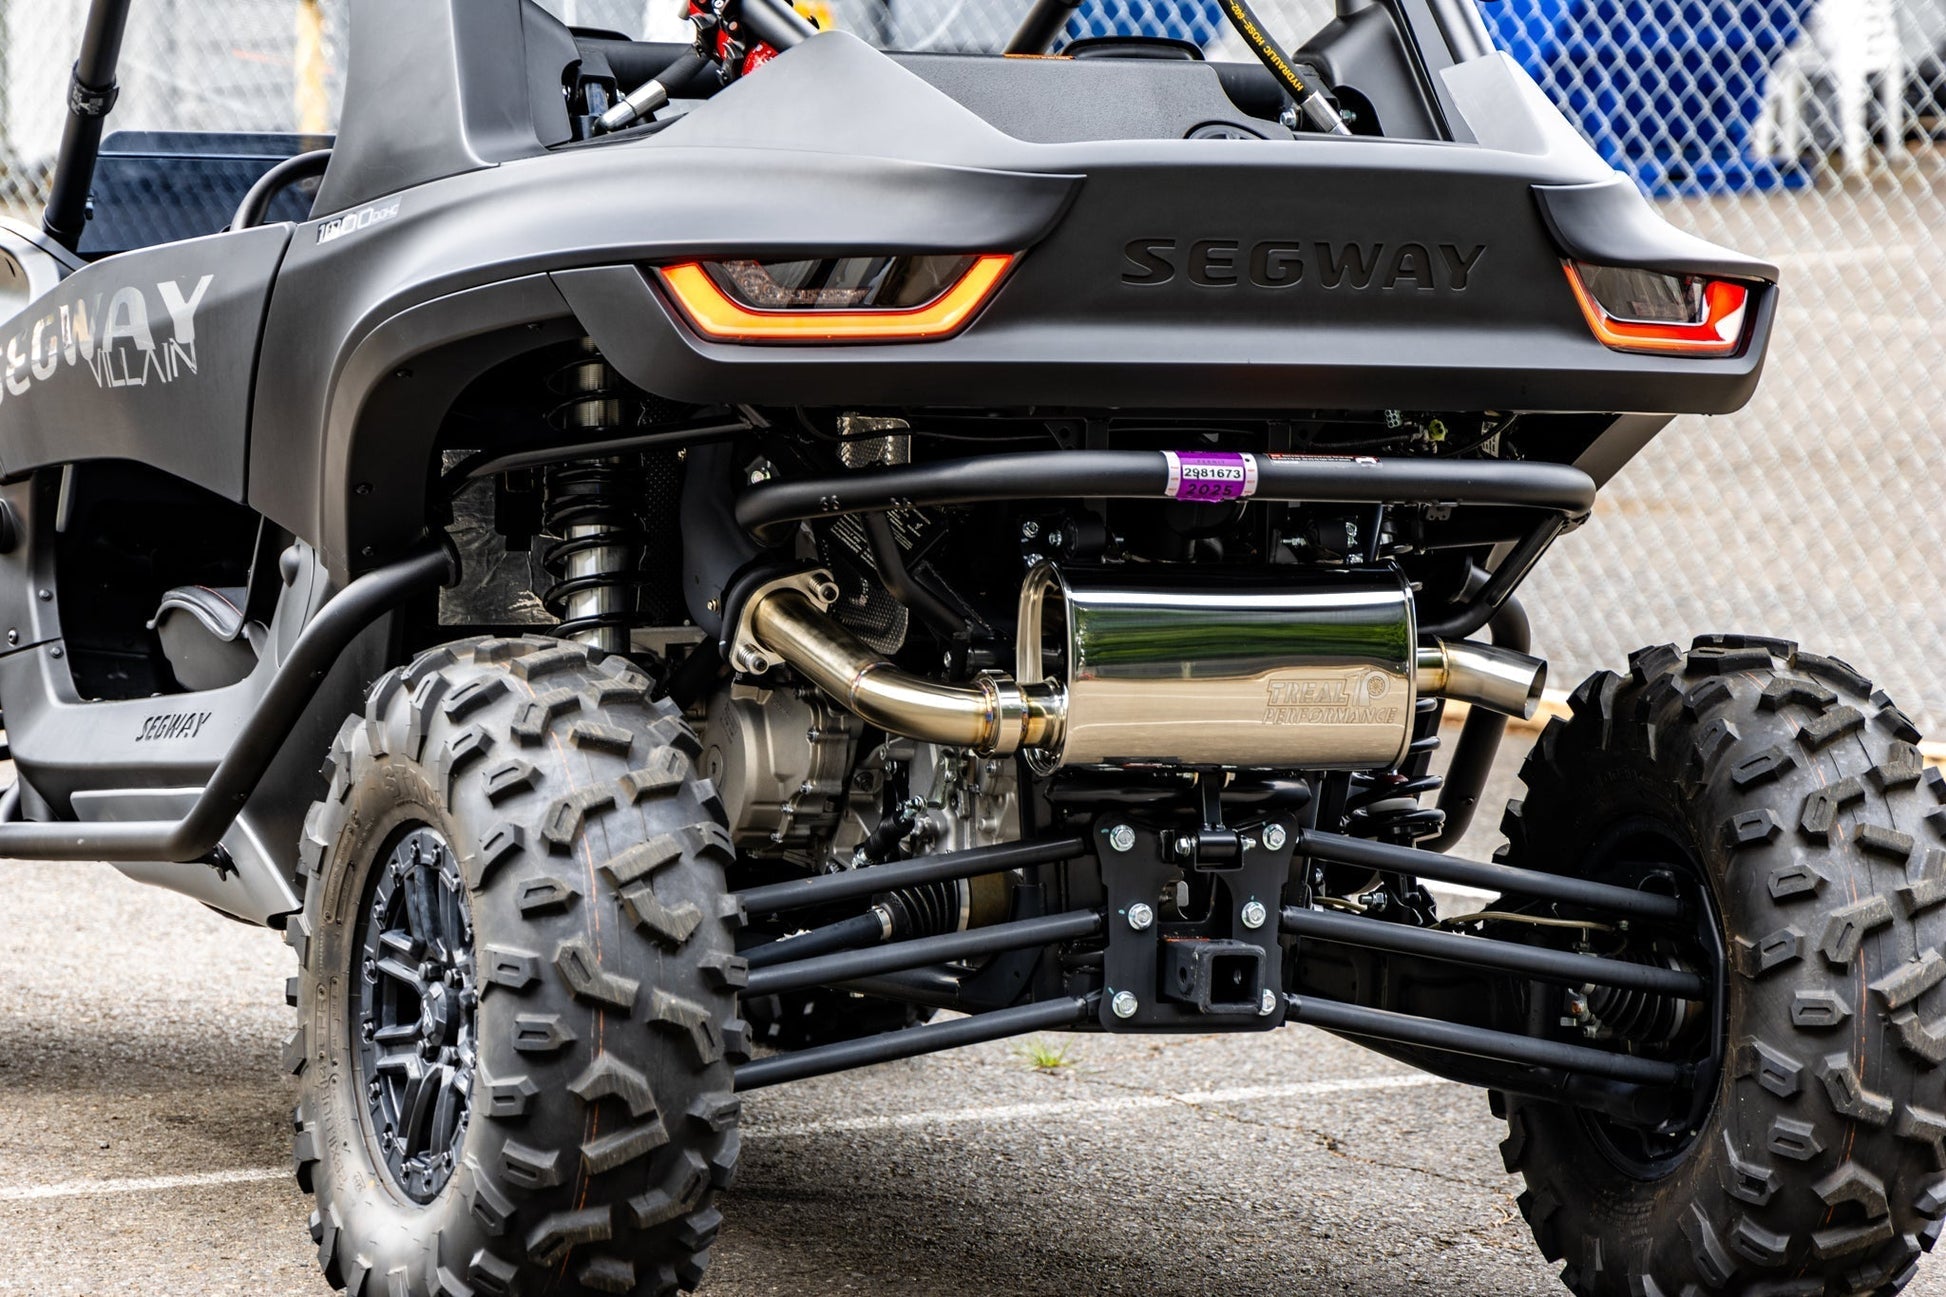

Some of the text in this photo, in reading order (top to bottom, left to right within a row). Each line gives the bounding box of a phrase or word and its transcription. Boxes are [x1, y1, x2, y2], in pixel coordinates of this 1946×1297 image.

[1263, 45, 1304, 92] HYDRAULIC
[1120, 238, 1488, 292] SEGWAY
[0, 274, 214, 404] EGWAY
[88, 337, 198, 388] VILLAIN
[1184, 467, 1241, 479] 2981673
[1186, 484, 1232, 496] 2025
[1270, 681, 1347, 705] TREAL
[135, 712, 212, 742] SEGWAY
[1262, 707, 1399, 725] PERFORMANCE
